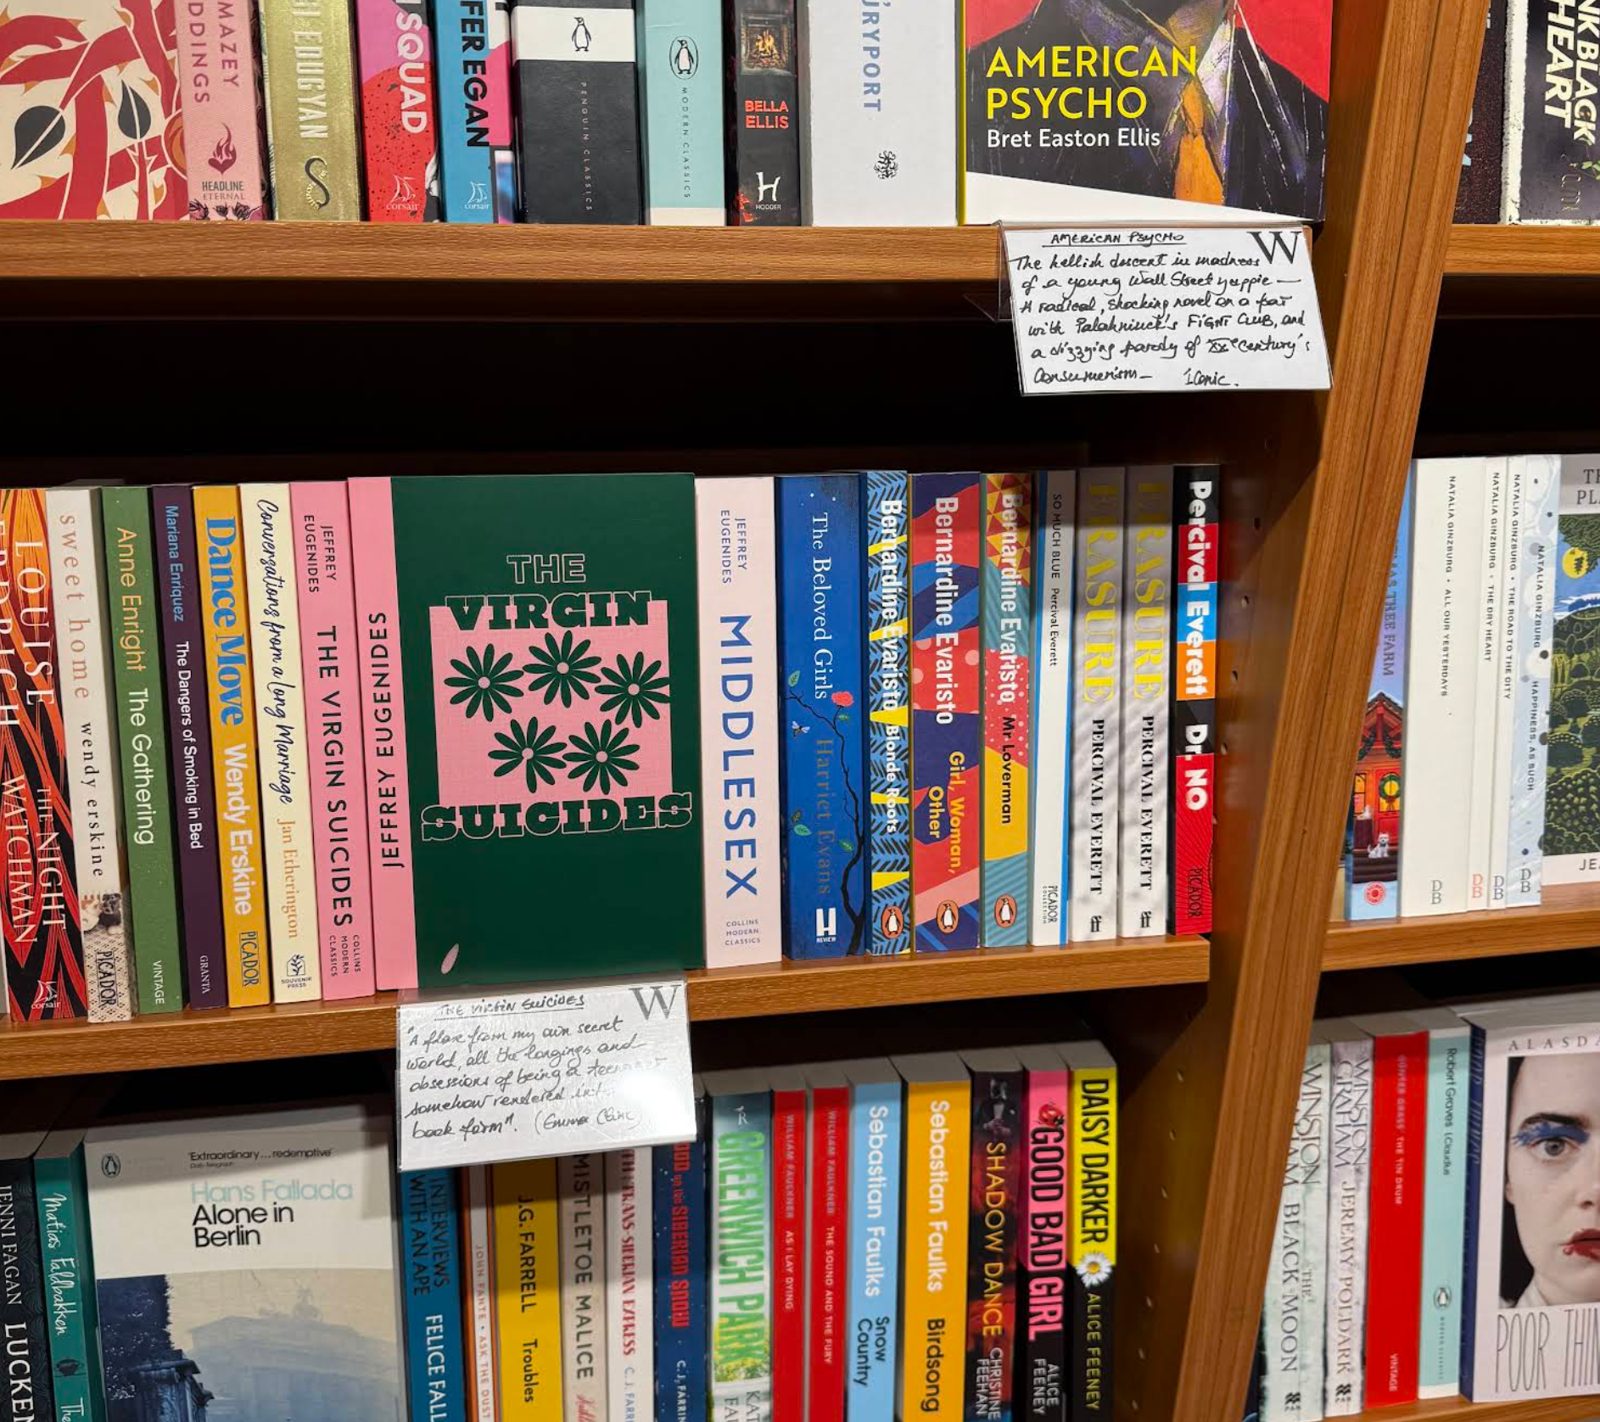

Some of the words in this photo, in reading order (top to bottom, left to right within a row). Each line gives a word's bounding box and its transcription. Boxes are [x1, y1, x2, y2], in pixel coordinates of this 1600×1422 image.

[217, 1, 239, 88] MAZEY
[396, 12, 428, 134] SQUAD
[985, 44, 1201, 78] AMERICAN
[463, 59, 491, 147] EGAN
[580, 81, 592, 140] PENGUIN
[681, 86, 690, 135] MODERN
[744, 100, 790, 112] BELLA
[745, 114, 790, 129] ELLIS
[986, 86, 1148, 119] PSYCHO
[986, 128, 1032, 149] Bret
[1038, 128, 1110, 148] Easton
[1117, 127, 1161, 148] Ellis
[202, 181, 244, 192] HEADLINE
[583, 149, 594, 211] CLASSICS
[683, 142, 692, 199] CLASSICS
[1052, 493, 1062, 510] SO
[1446, 475, 1457, 521] NATALIA
[1491, 471, 1501, 517] NATALIA
[1511, 473, 1521, 519] NATALIA
[117, 527, 138, 588] Anne
[165, 504, 179, 560] Mariana
[303, 514, 321, 593] EUGENIDES
[319, 524, 338, 581] JEFFREY
[719, 509, 733, 585] EUGENIDES
[734, 517, 748, 572] JEFFREY
[811, 511, 830, 551] The
[1000, 493, 1024, 613] Bernardine
[1052, 513, 1062, 548] MUCH
[1445, 521, 1456, 574] GINZBURG
[1488, 518, 1498, 571] GINZBURG
[1509, 520, 1519, 572] GINZBURG
[206, 516, 238, 628] Dance
[506, 553, 587, 585] THE
[934, 496, 959, 627] Bernardine
[1051, 550, 1061, 580] BLUE
[170, 561, 185, 623] Enriquez
[444, 590, 653, 632] VIRGIN
[812, 556, 834, 642] Beloved
[1050, 587, 1060, 628] Percival
[1444, 588, 1453, 609] ALL
[1486, 606, 1495, 626] DRY
[1487, 584, 1496, 604] THE
[1507, 586, 1516, 607] THE
[14, 540, 55, 706] LOUISE
[120, 594, 148, 672] Enright
[1048, 629, 1059, 667] Everett
[1442, 611, 1453, 633] OUR
[1483, 627, 1494, 663] HEART
[1505, 637, 1514, 653] TO
[1506, 608, 1515, 635] ROAD
[176, 641, 191, 668] The
[215, 634, 247, 726] Move
[316, 625, 339, 680] THE
[813, 647, 835, 700] Girls
[934, 631, 959, 725] Evaristo
[999, 617, 1022, 704] Evaristo
[1382, 634, 1397, 677] FARM
[1440, 634, 1451, 697] YESTERDAYS
[1504, 655, 1513, 676] THE
[128, 687, 149, 727] The
[178, 670, 194, 727] Dangers
[368, 612, 395, 757] EUGENIDES
[1503, 676, 1512, 701] CITY
[182, 729, 198, 743] of
[321, 690, 346, 788] VIRGIN
[1001, 715, 1016, 740] Mr
[183, 745, 202, 805] Smoking
[223, 743, 252, 825] Wendy
[719, 614, 759, 900] MIDDLESEX
[816, 738, 836, 820] Harriet
[948, 751, 966, 793] Girl,
[1001, 744, 1016, 825] Loverman
[131, 734, 157, 847] Gathering
[187, 808, 201, 820] in
[376, 768, 406, 869] JEFFREY
[420, 791, 693, 842] SUICIDES
[928, 785, 945, 839] Other
[2, 774, 38, 944] WATCHMAN
[189, 823, 205, 850] Bed
[326, 799, 355, 927] SUICIDES
[816, 829, 837, 896] Evans
[948, 797, 966, 874] Woman,
[229, 827, 254, 916] Erskine
[1046, 884, 1059, 924] PICADOR
[96, 950, 117, 1008] PICADOR
[152, 960, 166, 1005] VINTAGE
[199, 954, 212, 995] GRANTA
[239, 930, 261, 989] PICADOR
[1080, 1079, 1110, 1148] DAISY
[1301, 1062, 1323, 1186] WINSTON
[1334, 1060, 1353, 1169] GRAHAM
[1351, 1057, 1369, 1167] WINSTON
[867, 1104, 889, 1220] Sebastian
[928, 1099, 951, 1215] Sebastian
[1029, 1126, 1065, 1203] GOOD
[191, 1181, 256, 1203] Hans
[260, 1176, 354, 1202] Fallada
[191, 1203, 268, 1227] Alone
[272, 1202, 295, 1223] in
[408, 1174, 428, 1223] WITH
[517, 1194, 535, 1228] J.G.
[717, 1130, 768, 1287] GREENWICH
[984, 1141, 1007, 1253] SHADOW
[1080, 1152, 1110, 1245] DARKER
[193, 1224, 262, 1249] Berlin
[410, 1226, 429, 1259] AN
[429, 1175, 451, 1289] INTERVIEWS
[570, 1154, 594, 1286] MISTLETOE
[1028, 1211, 1064, 1269] BAD
[1283, 1202, 1300, 1284] BLACK
[1339, 1180, 1356, 1267] JEREMY
[412, 1260, 431, 1297] APE
[520, 1231, 538, 1313] FARRELL
[864, 1225, 886, 1298] Faulks
[927, 1220, 949, 1294] Faulks
[982, 1261, 1004, 1337] DANCE
[1028, 1276, 1065, 1342] GIRL
[1086, 1292, 1102, 1342] ALICE
[1337, 1276, 1354, 1375] POLDARK
[575, 1294, 595, 1380] MALICE
[717, 1295, 769, 1367] PARK
[852, 1317, 873, 1388] Country
[874, 1315, 891, 1363] Snow
[1280, 1295, 1299, 1373] MOON
[1495, 1311, 1551, 1393] POOR
[522, 1338, 541, 1403] Troubles
[920, 1318, 947, 1413] Birdsong
[975, 1358, 991, 1416] FEEHAN
[987, 1346, 1004, 1421] CHRISTINE
[1032, 1358, 1048, 1416] FEENEY
[1046, 1362, 1060, 1406] ALICE
[1085, 1347, 1101, 1410] FEENEY
[1388, 1352, 1399, 1392] VINTAGE
